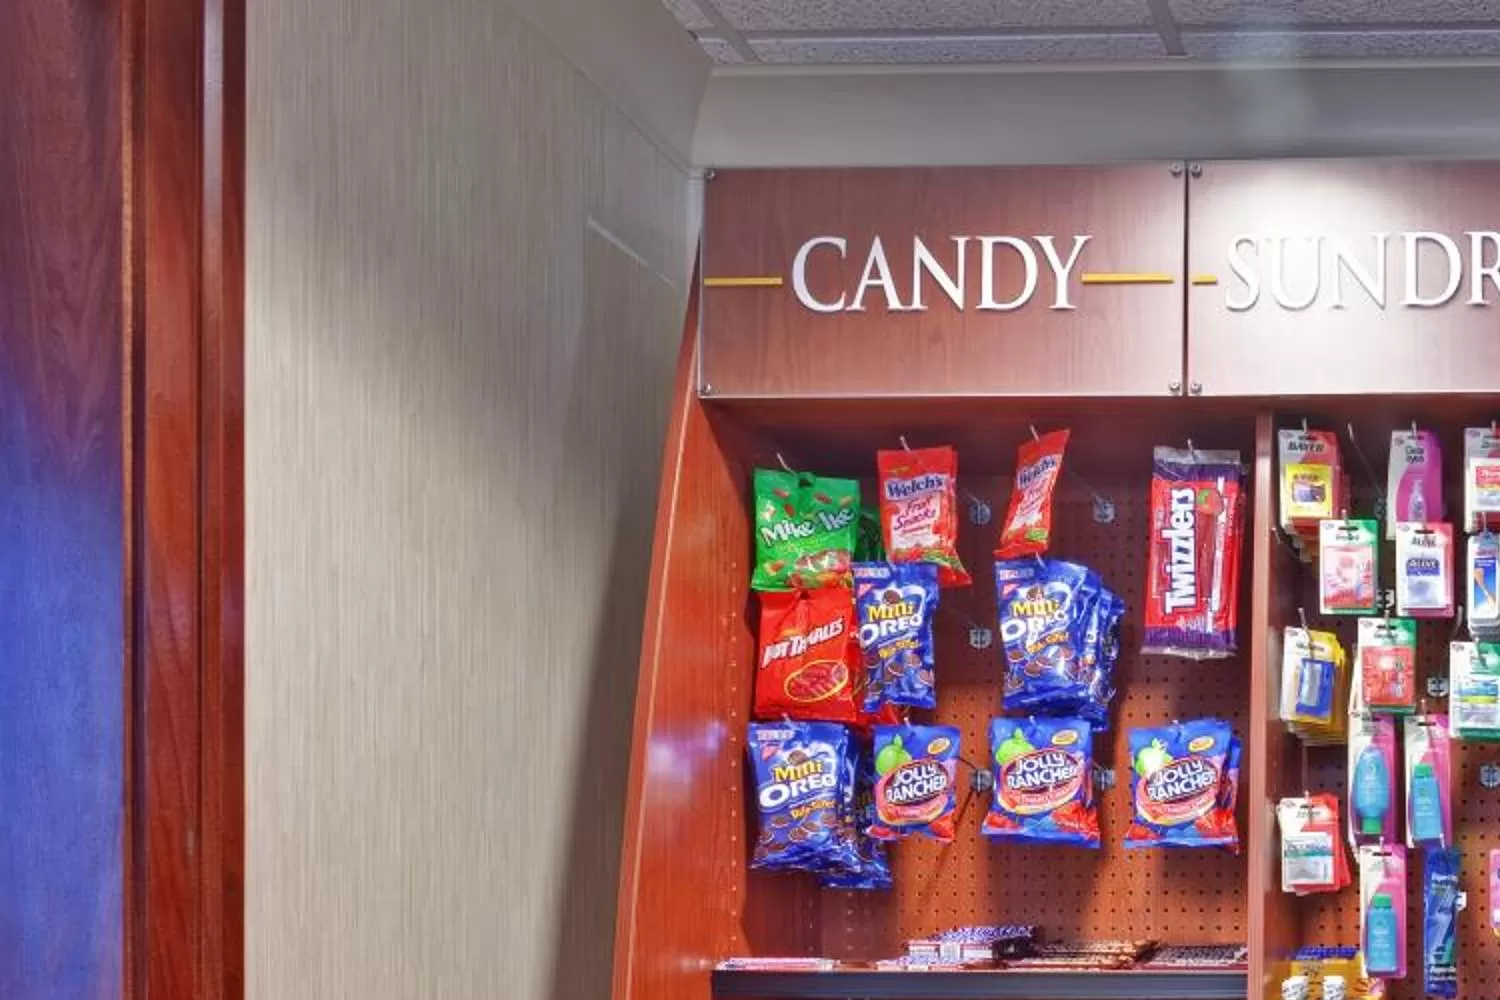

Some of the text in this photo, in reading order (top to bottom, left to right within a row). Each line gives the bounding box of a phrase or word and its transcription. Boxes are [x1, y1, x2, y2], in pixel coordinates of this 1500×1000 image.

[792, 234, 1092, 313] CANDY
[868, 601, 914, 623] Mini
[859, 615, 922, 648] OREO
[773, 759, 824, 784] Mini
[1015, 753, 1065, 775] JOLLY
[1154, 760, 1204, 785] JOLLY
[759, 773, 837, 808] OREO
